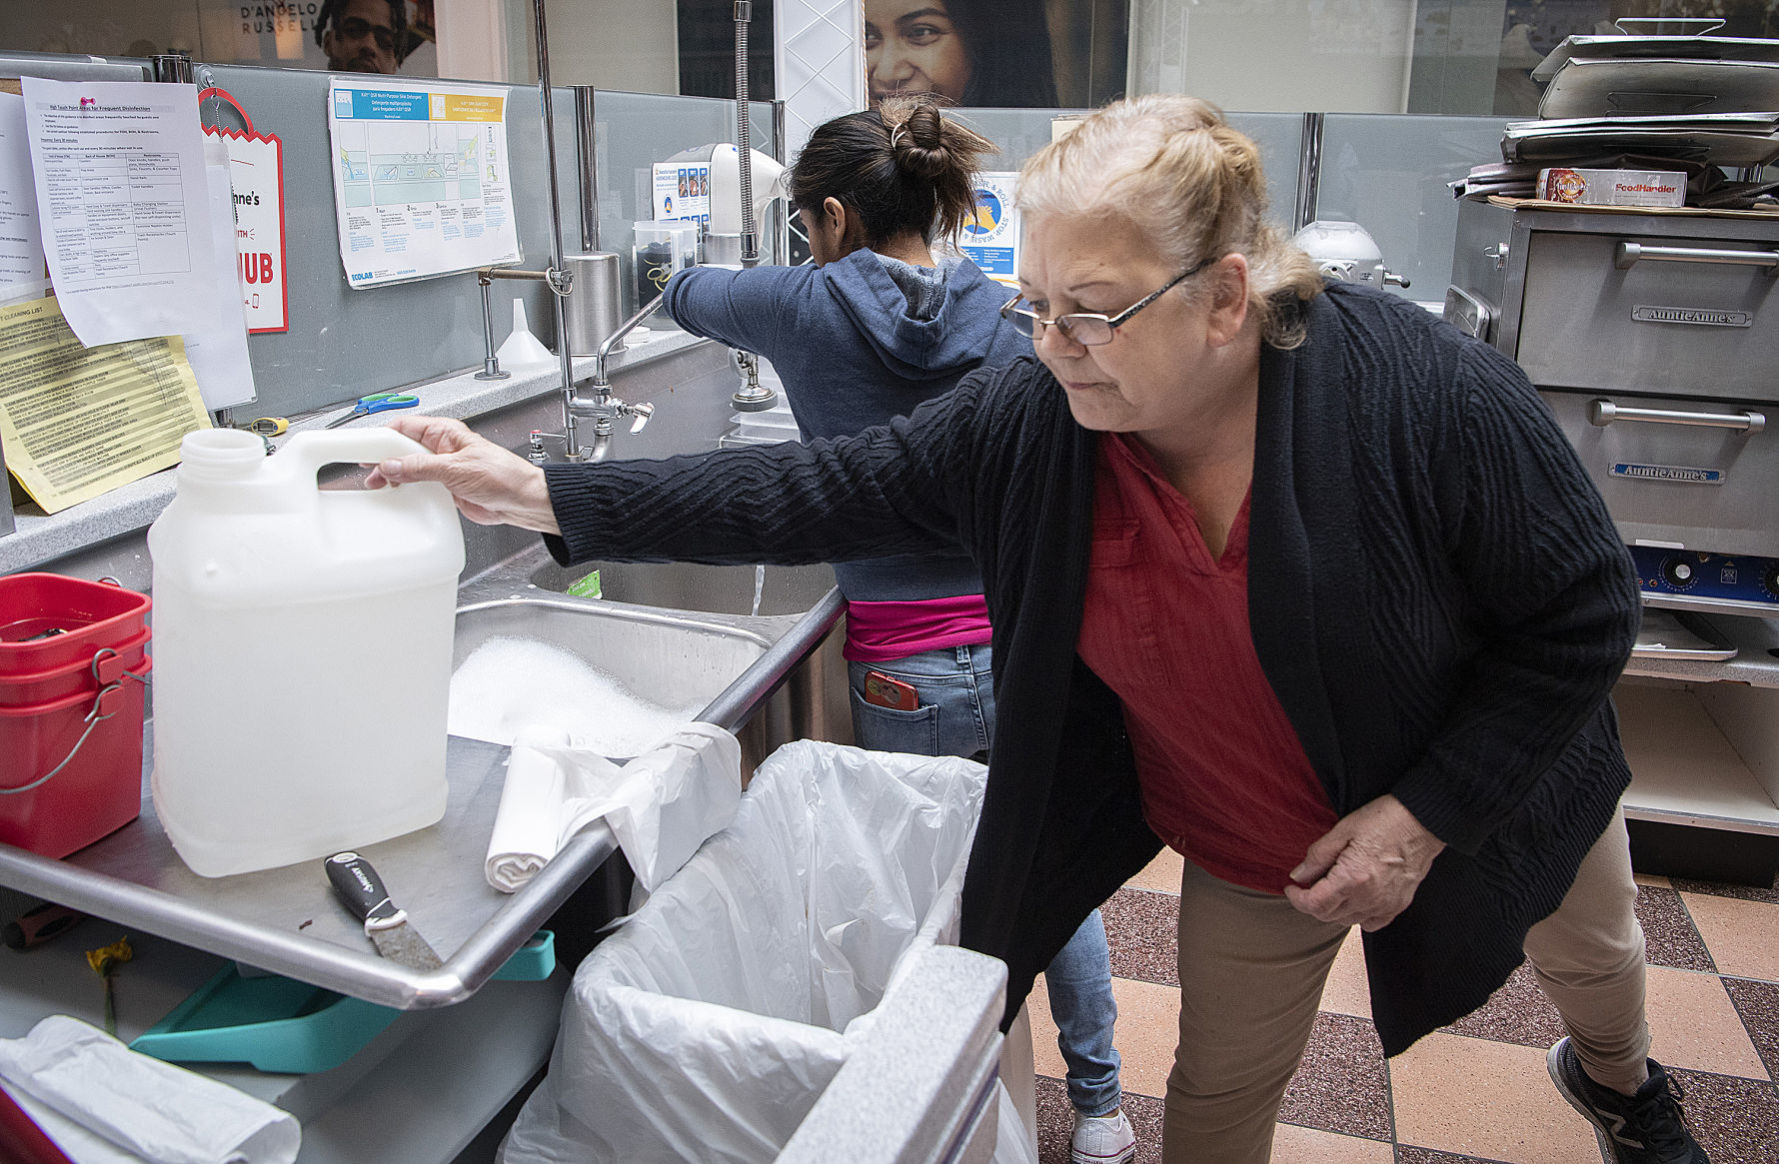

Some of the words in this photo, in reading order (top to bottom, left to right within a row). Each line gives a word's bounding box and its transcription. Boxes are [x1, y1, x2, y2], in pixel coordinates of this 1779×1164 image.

[241, 3, 317, 18] D'ANGELO
[242, 20, 316, 34] RUSSELL
[1615, 183, 1677, 194] FoodHandler
[233, 190, 260, 206] nne's
[237, 230, 248, 238] ITH
[31, 306, 43, 315] LIST
